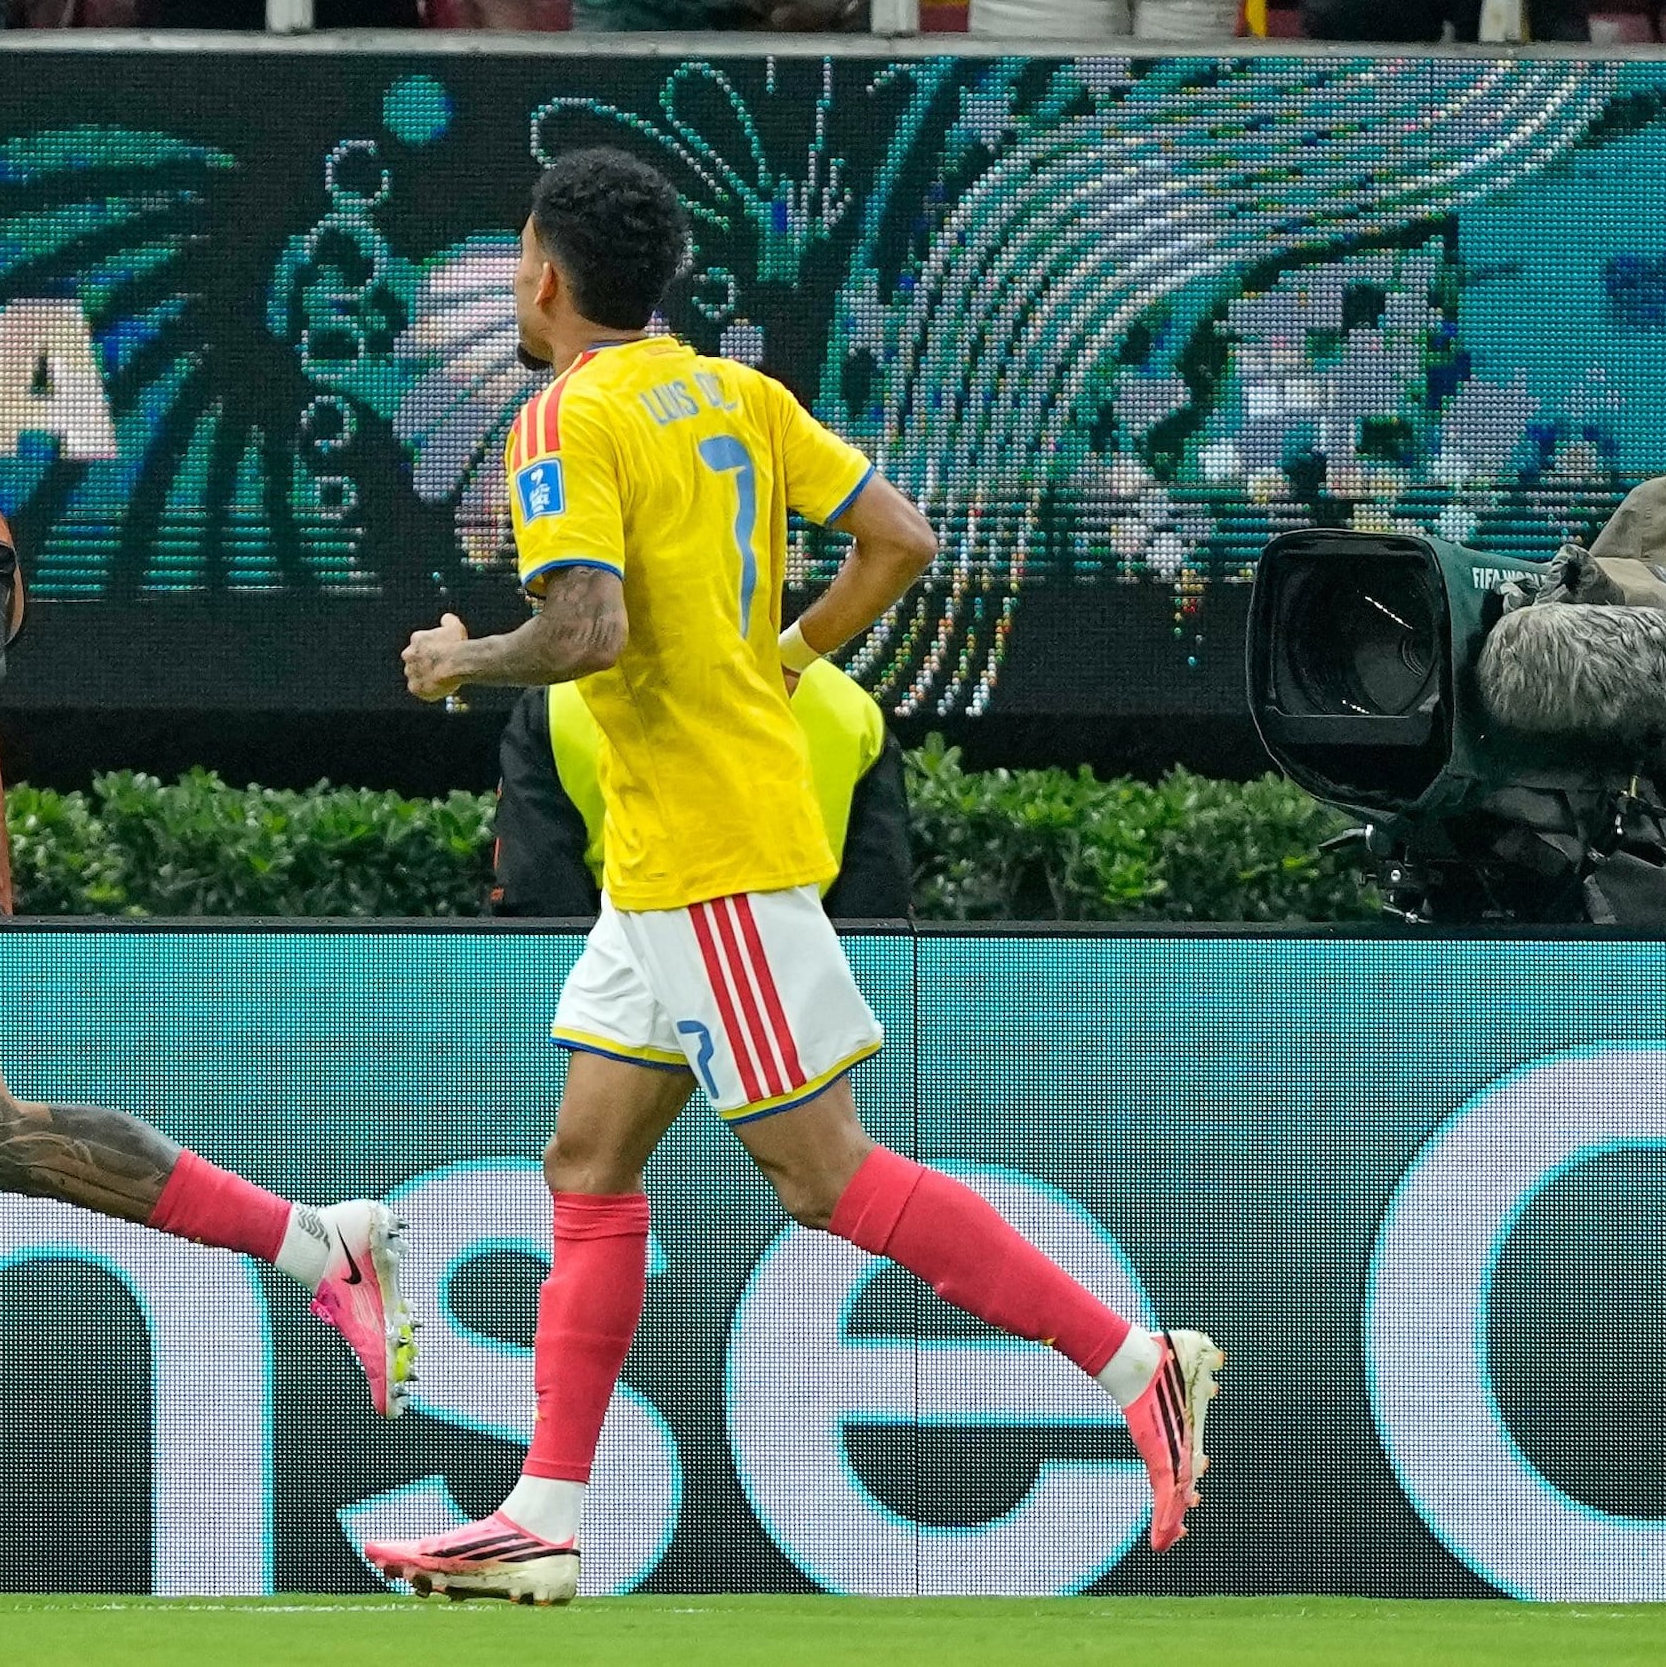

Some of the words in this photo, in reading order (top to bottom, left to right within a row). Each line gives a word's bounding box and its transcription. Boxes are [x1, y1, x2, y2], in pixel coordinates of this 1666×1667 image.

[637, 380, 700, 425] LUIS
[697, 433, 758, 641] 7
[676, 1019, 721, 1101] 7
